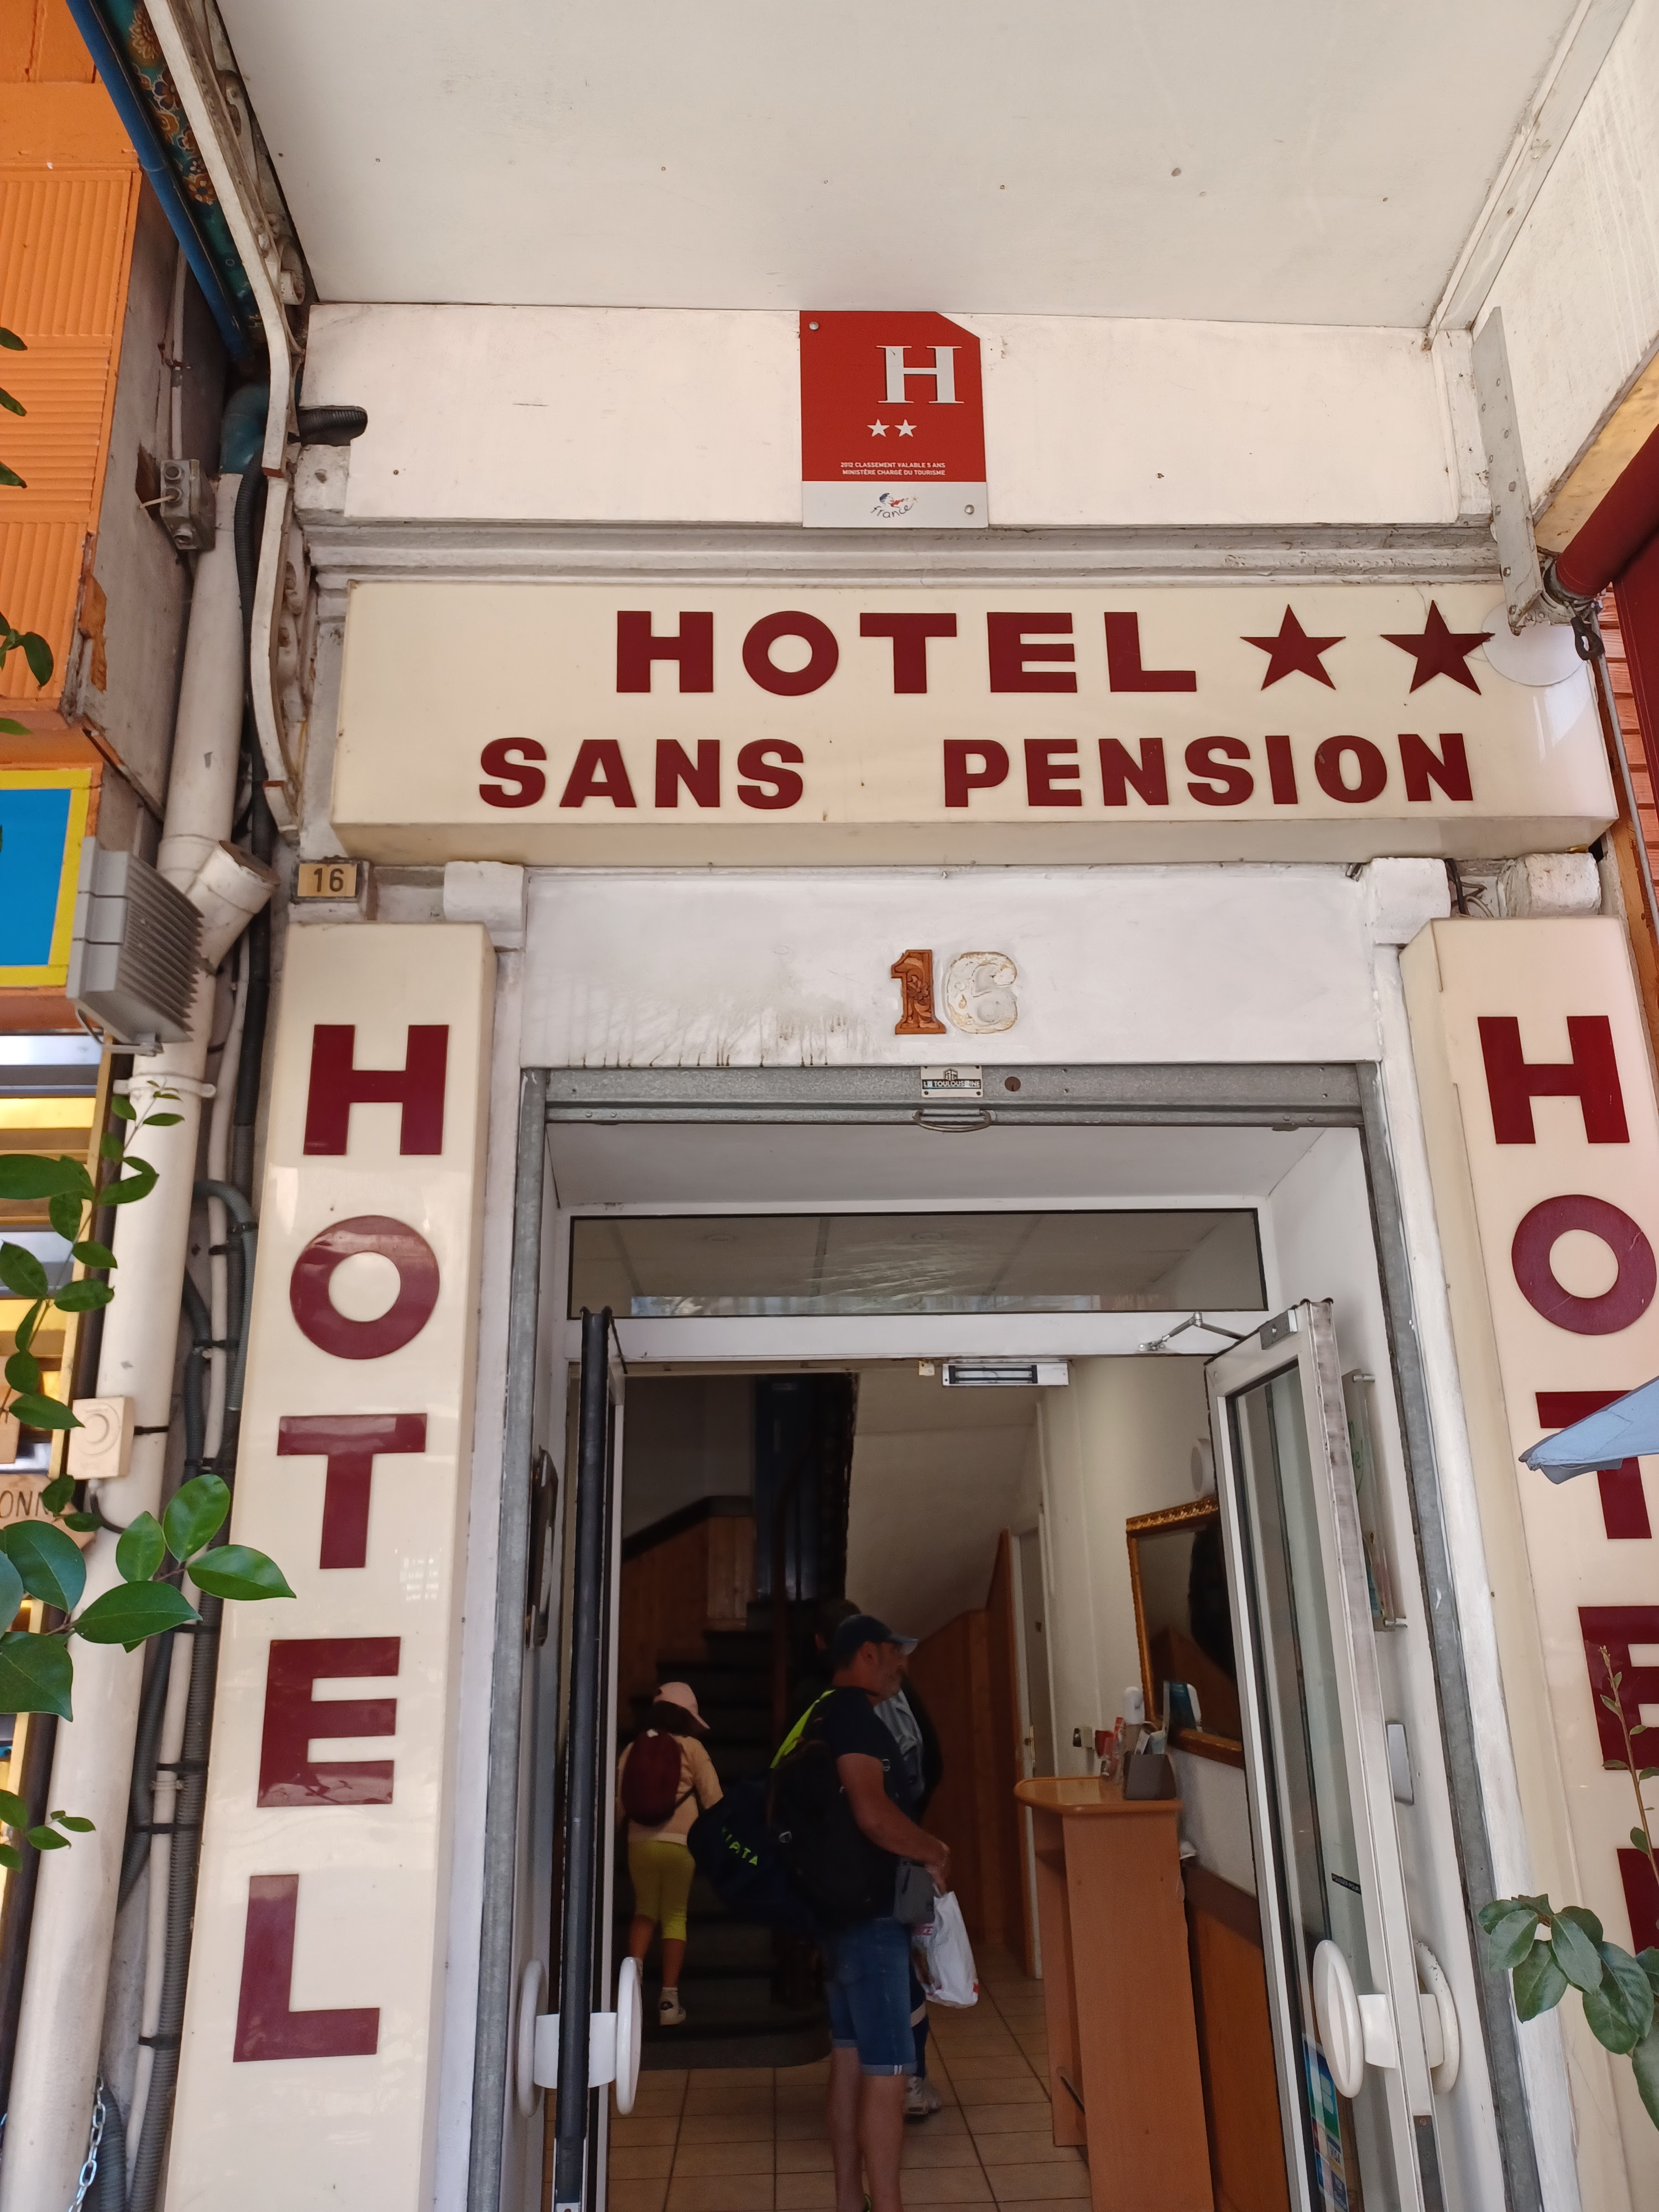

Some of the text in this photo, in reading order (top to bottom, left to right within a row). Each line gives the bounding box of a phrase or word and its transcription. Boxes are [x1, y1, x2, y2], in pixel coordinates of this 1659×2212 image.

[876, 345, 965, 404] H
[616, 610, 1197, 697] HOTEL
[479, 733, 1473, 810] SANS PENSION
[314, 867, 344, 893] 16
[891, 949, 1018, 1035] 16
[233, 1024, 449, 2063] HOTEL
